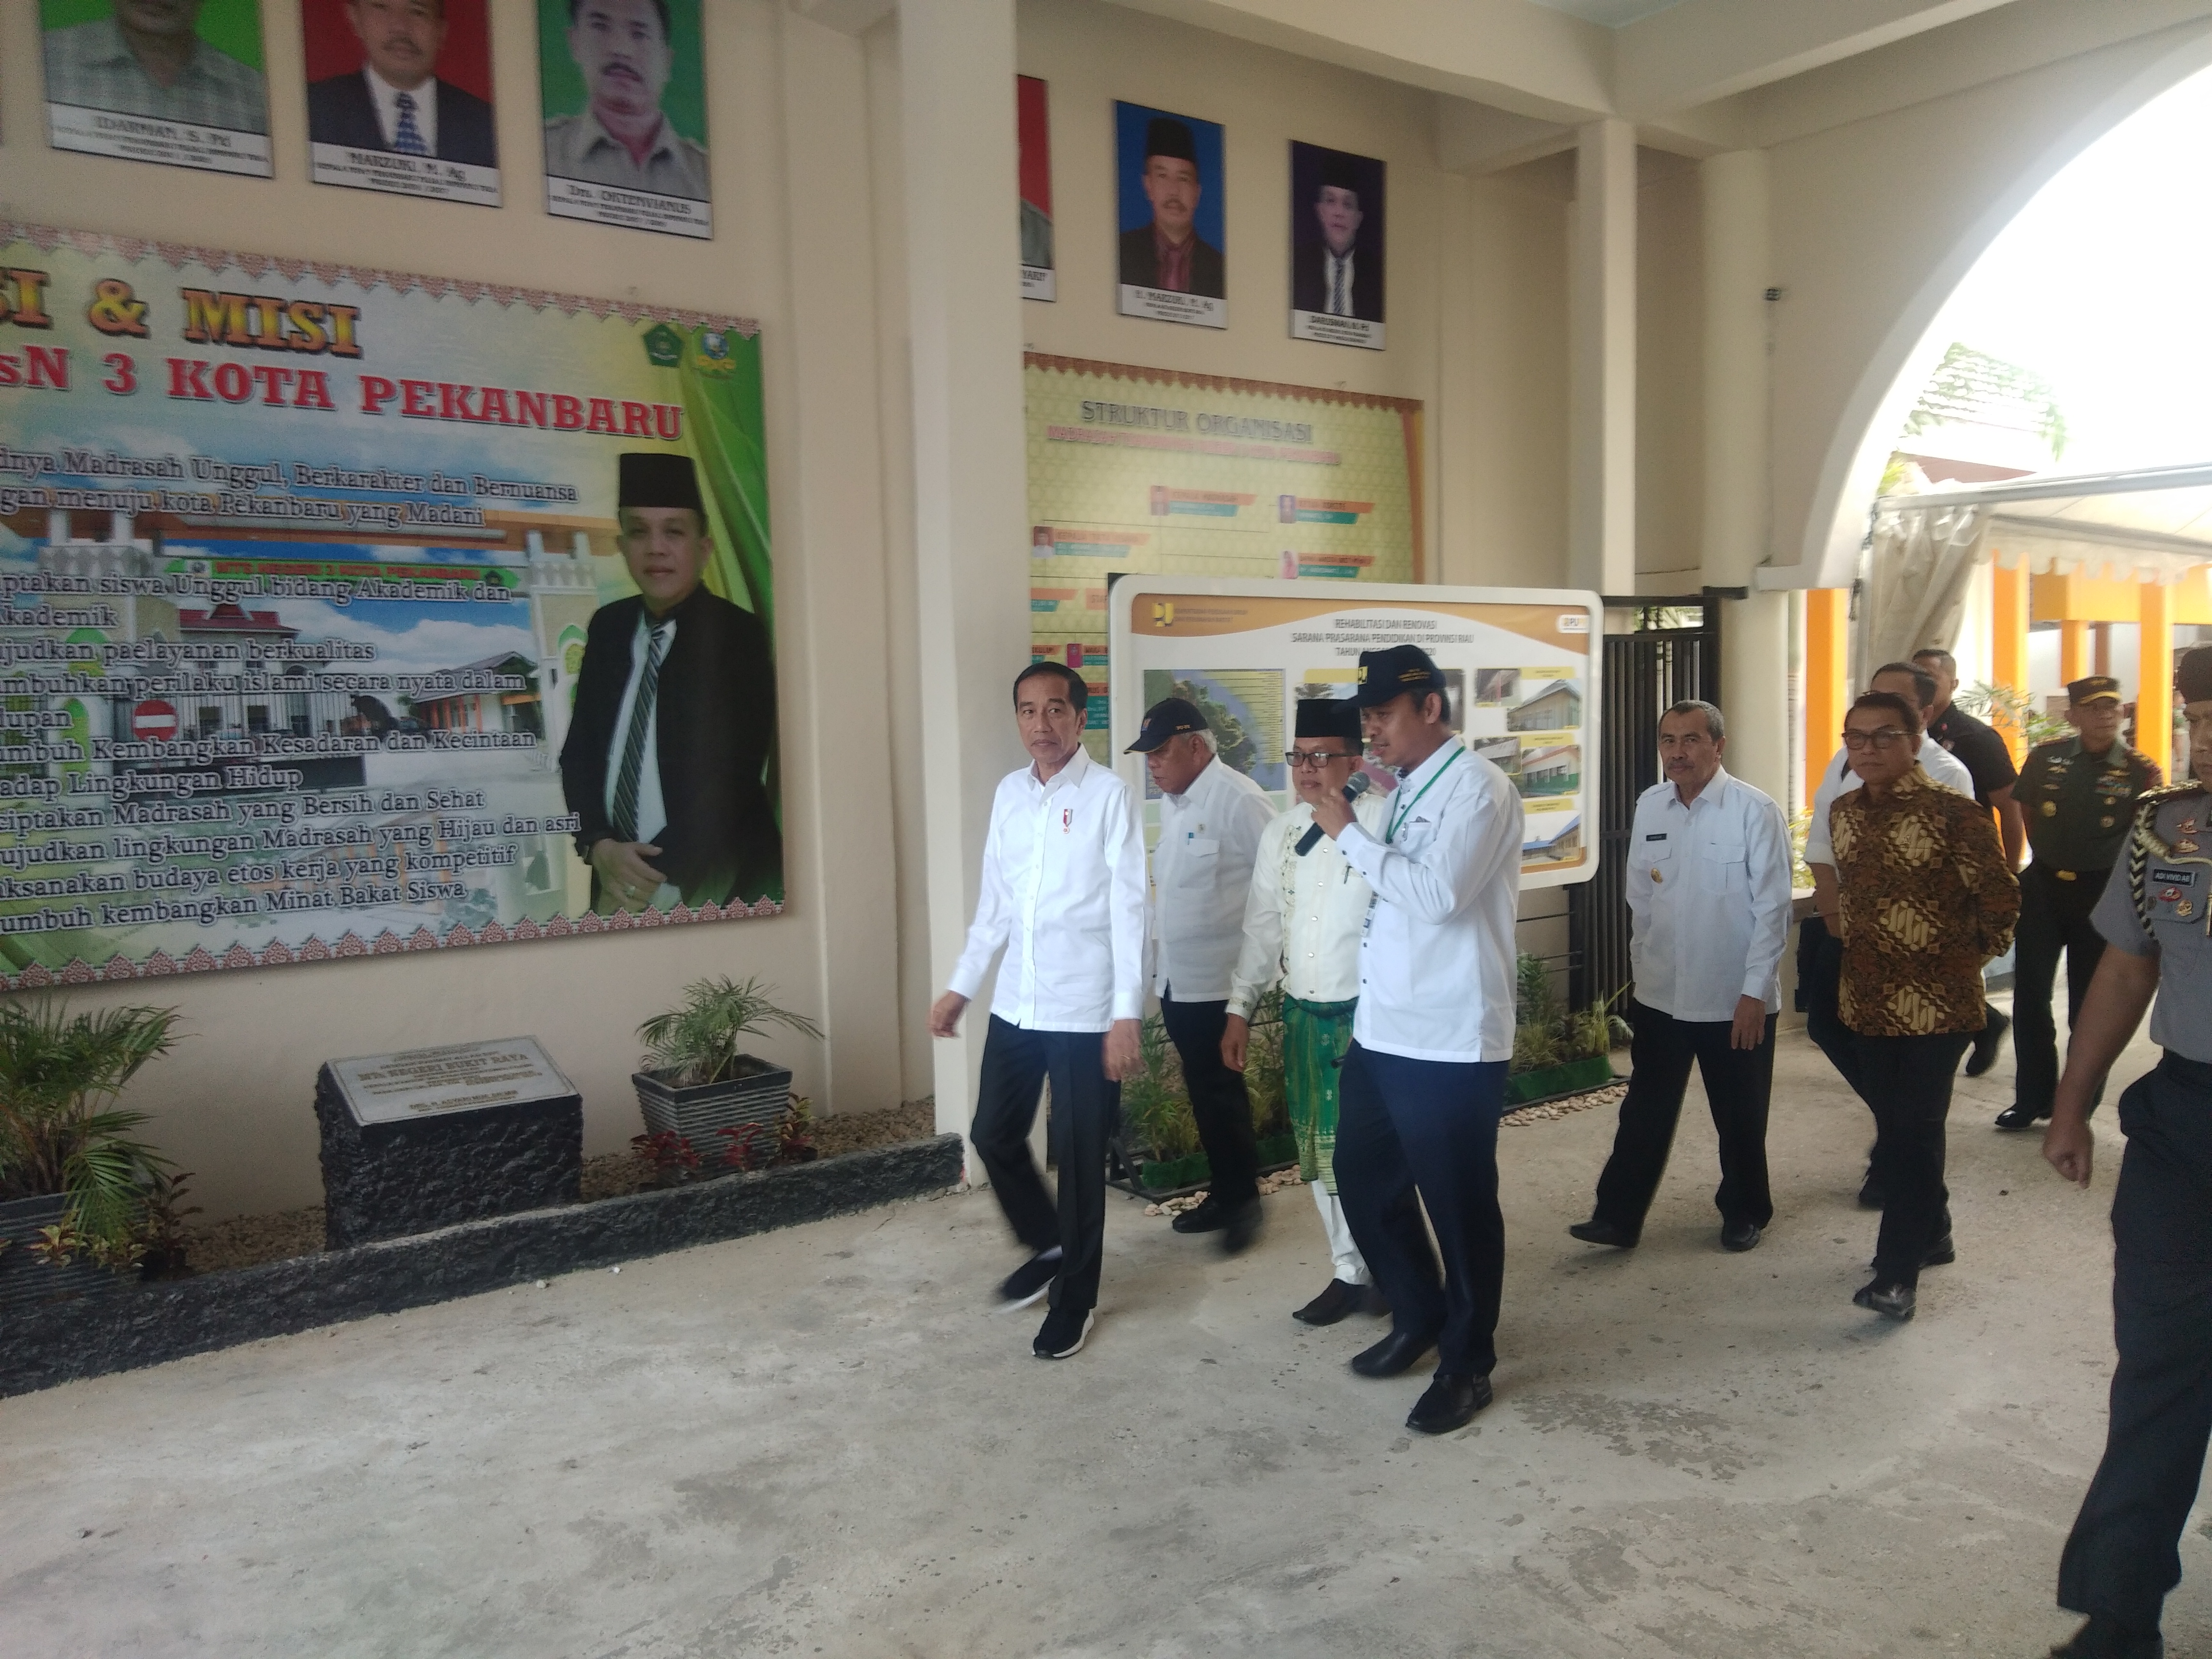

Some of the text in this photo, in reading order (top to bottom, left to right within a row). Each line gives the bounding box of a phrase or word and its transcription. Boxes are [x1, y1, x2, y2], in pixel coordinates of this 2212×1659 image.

[0, 267, 363, 359] I & MISI
[102, 352, 137, 394] 3
[166, 357, 336, 409] KOTA
[359, 375, 684, 440] PEKANBARU
[1082, 400, 1312, 443] STRUKTUR ORGANISASI
[64, 450, 183, 478] Madrasah
[293, 463, 425, 492] Berkarakter
[432, 471, 469, 494] dan
[57, 489, 155, 516] menuju
[161, 490, 215, 512] kota
[220, 493, 342, 519] Pekanbaru
[347, 503, 402, 528] yang
[406, 502, 484, 526] Madani
[101, 574, 164, 594] siswa
[176, 575, 264, 603] Unggul
[271, 576, 351, 605] bidang
[356, 578, 469, 601] Akademik
[473, 582, 511, 602] dan
[1291, 633, 1323, 643] SARANA
[1326, 633, 1370, 643] PRASARANA
[1372, 633, 1415, 643] PENDIDIKAN
[1426, 634, 1457, 643] PROVINSI
[1335, 619, 1385, 629] REHABILITASI
[1386, 619, 1401, 629] DAN
[247, 637, 376, 661] berkualitas
[1336, 647, 1360, 656] TAHUN
[135, 672, 239, 700] perilaku
[243, 671, 316, 693] islami
[322, 673, 393, 691] secara
[398, 672, 456, 697] nyata
[463, 670, 526, 691] dalam
[92, 736, 256, 765] Kembangkan
[263, 733, 380, 755] Kesadaran
[387, 731, 426, 752] dan
[433, 730, 536, 750] Kecintaan
[69, 770, 222, 800] Lingkungan
[226, 767, 303, 792] Hidup
[112, 802, 231, 826] Madrasah
[238, 800, 297, 824] yang
[302, 792, 374, 816] Bersih
[381, 791, 420, 812] dan
[427, 788, 485, 809] Sehat
[113, 834, 255, 864] lingkungan
[263, 821, 373, 849] Madrasah
[380, 823, 433, 848] yang
[438, 817, 497, 843] Hijau
[503, 815, 538, 836] dan
[545, 813, 581, 832] asri
[133, 867, 219, 894] budaya
[227, 865, 275, 884] etos
[280, 859, 338, 883] kerja
[345, 855, 400, 882] yang
[405, 845, 517, 874] kompetitif
[100, 896, 258, 925] kembangkan
[266, 888, 333, 912] Minat
[340, 884, 400, 906] Bakat
[408, 880, 467, 902] Siswa
